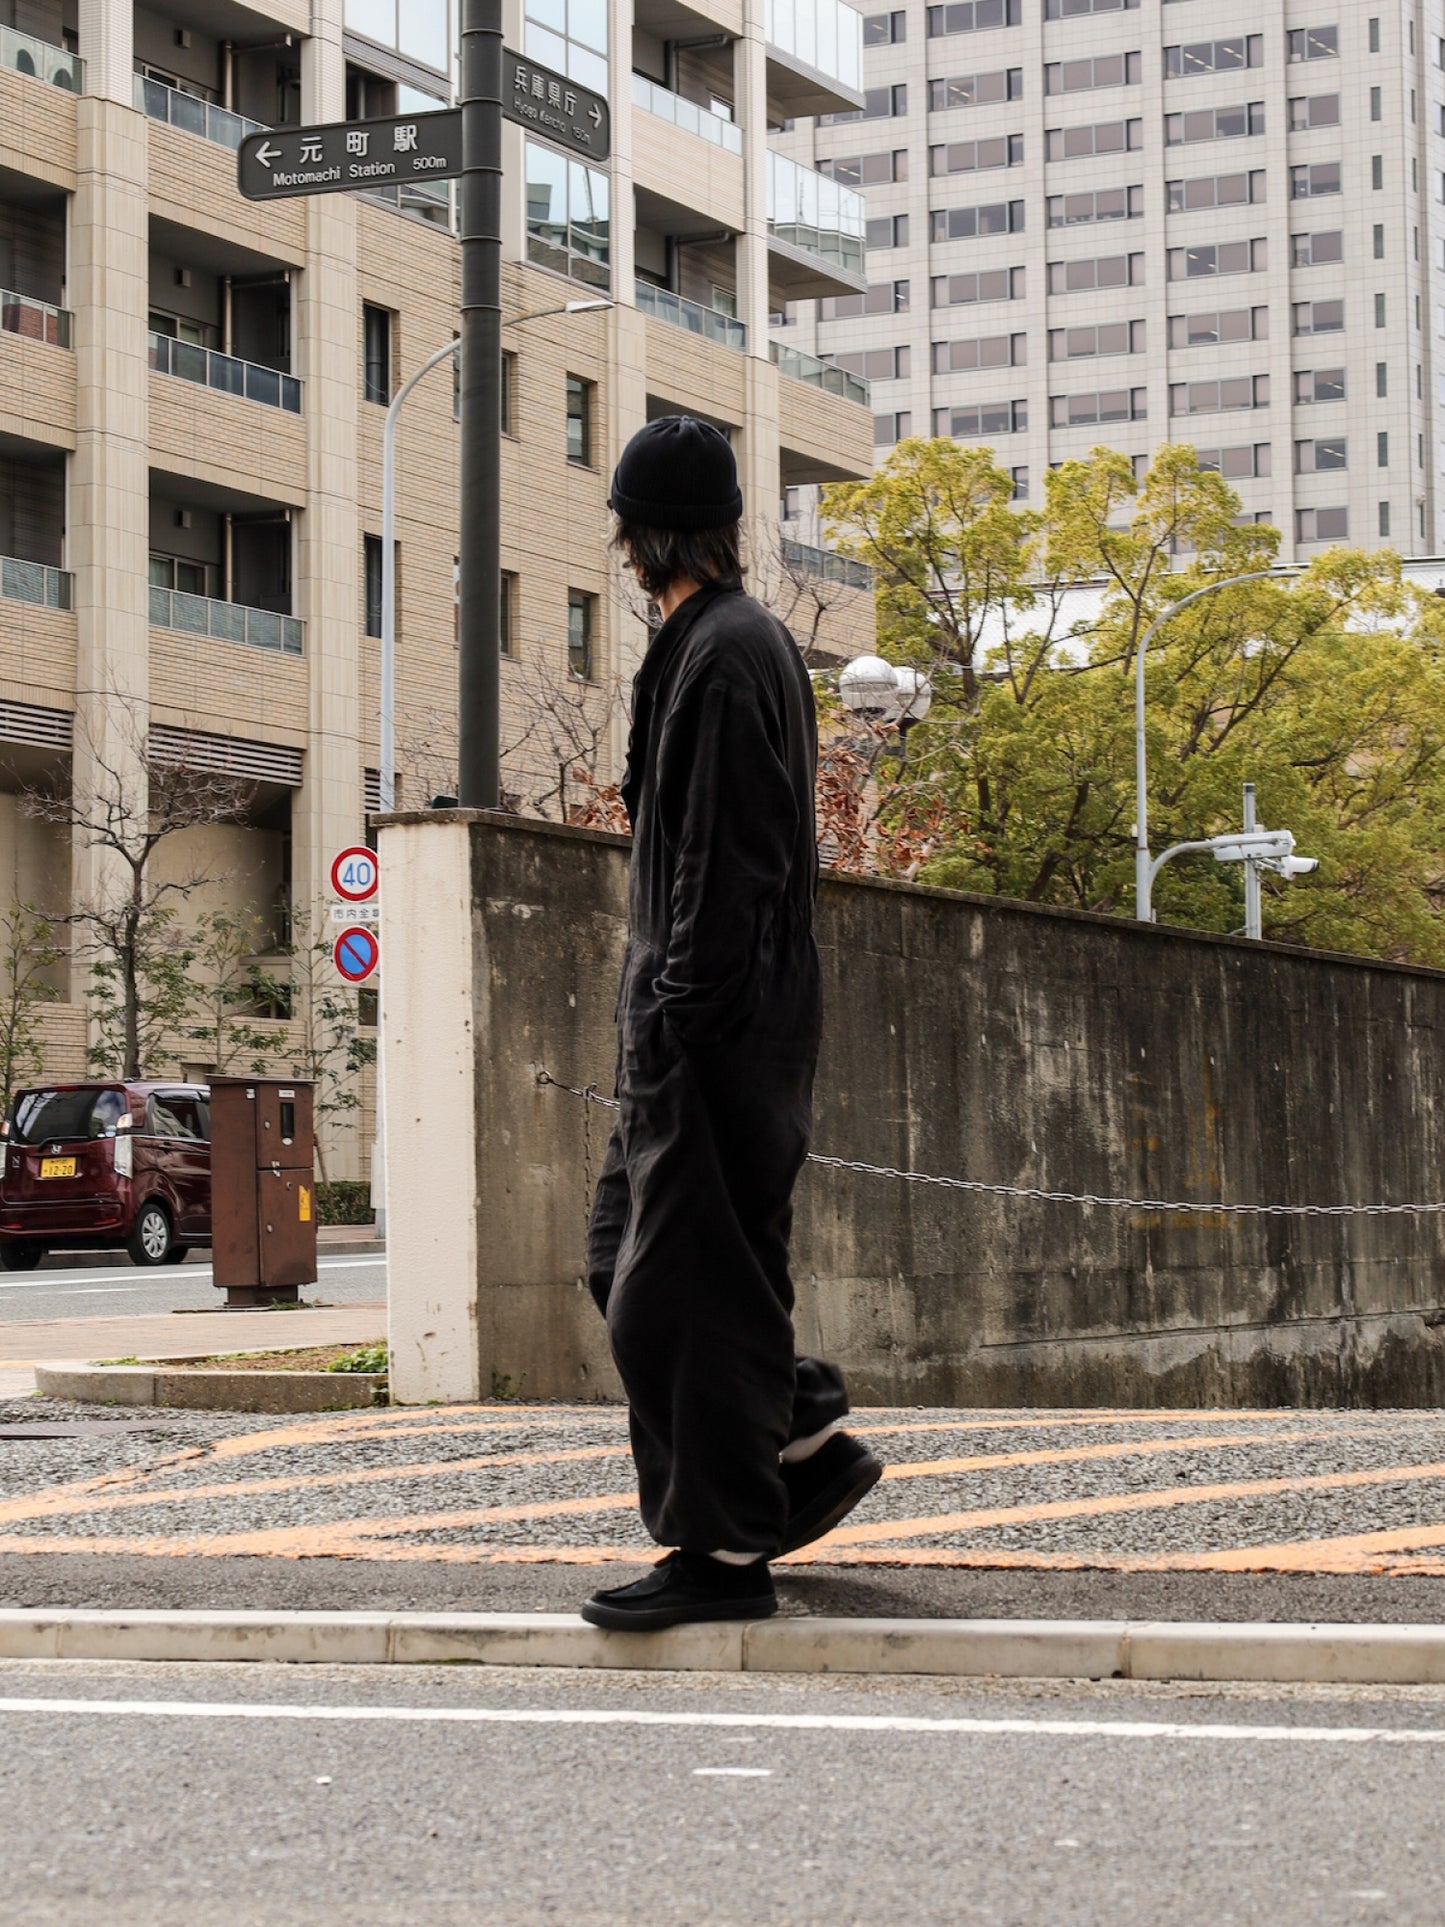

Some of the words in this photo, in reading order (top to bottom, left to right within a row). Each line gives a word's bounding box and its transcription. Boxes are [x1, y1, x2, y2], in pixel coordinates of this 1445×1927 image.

[514, 65, 577, 116] 兵庫県庁
[299, 124, 418, 163] 元町駅
[273, 167, 340, 186] Motomachi
[349, 162, 395, 178] Station
[413, 156, 447, 171] 500m
[342, 862, 371, 886] 40
[48, 1165, 73, 1176] 12-20
